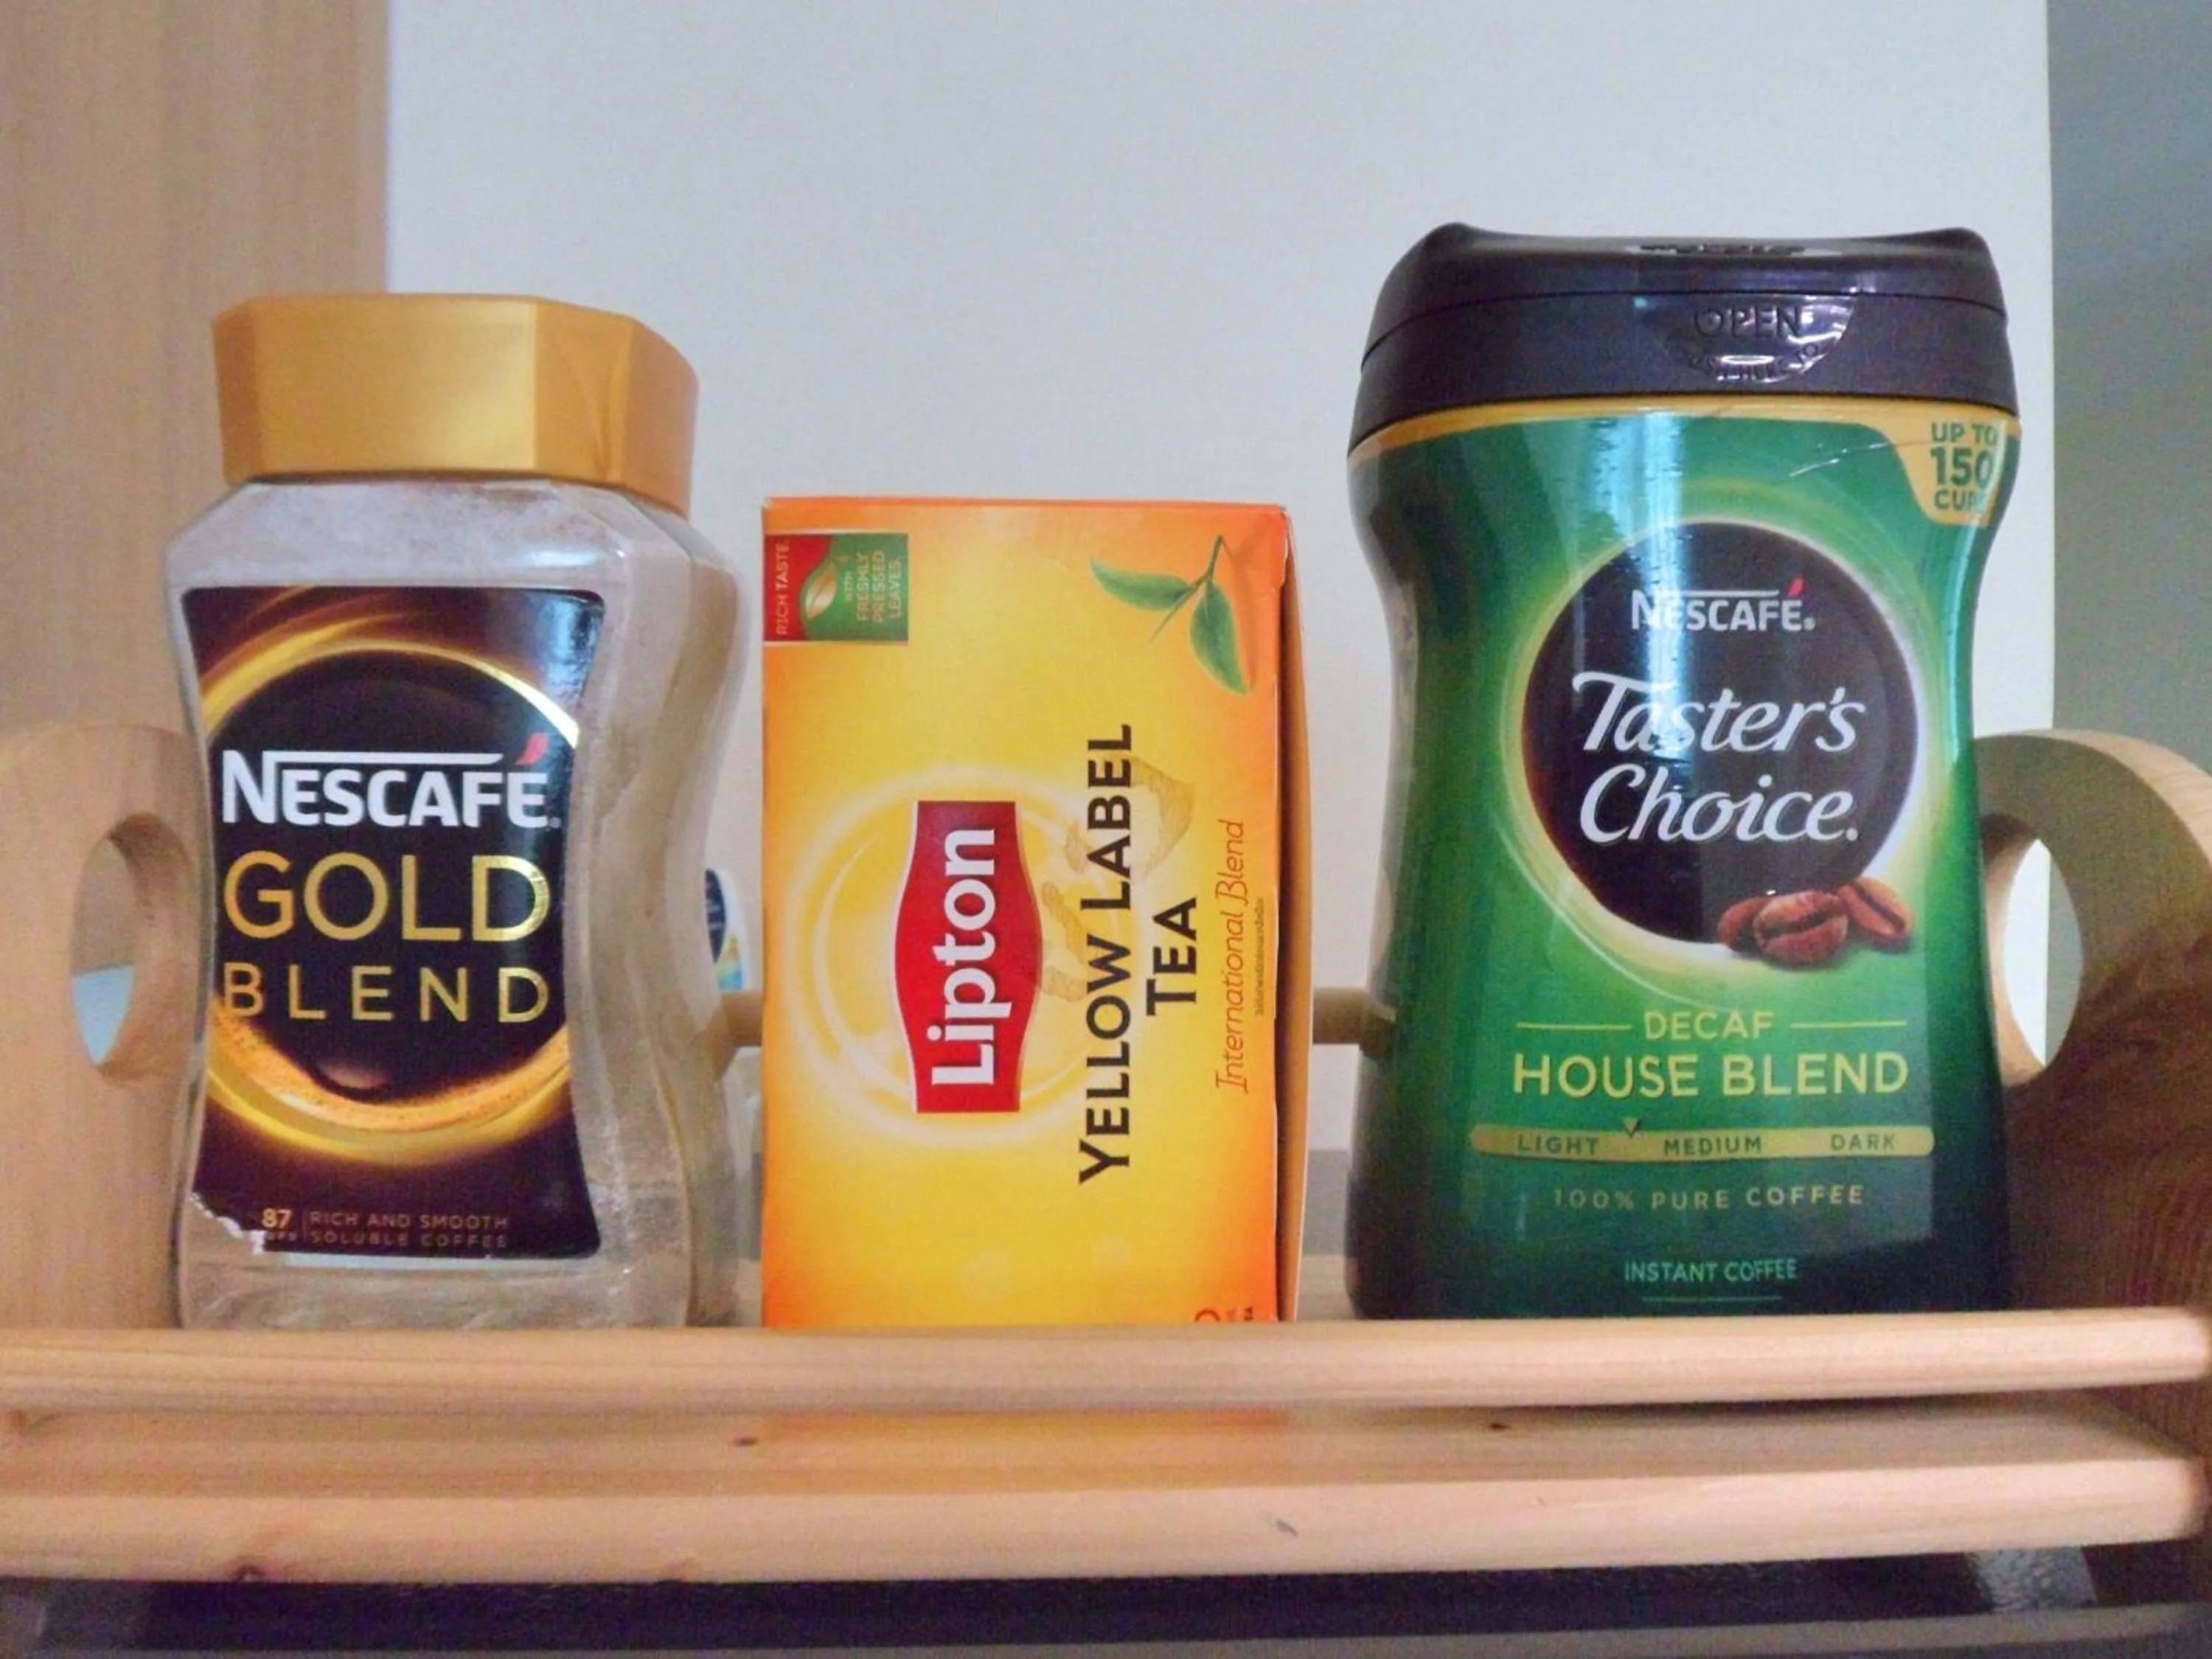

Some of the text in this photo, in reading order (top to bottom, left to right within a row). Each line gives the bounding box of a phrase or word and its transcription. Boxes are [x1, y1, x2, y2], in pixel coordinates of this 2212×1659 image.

[1697, 305, 1801, 338] OPEN
[1931, 422, 1997, 446] UP TO
[1930, 446, 1995, 488] 150
[857, 552, 869, 622] FRESHLY
[872, 551, 885, 623] PRESSED
[776, 593, 789, 635] RICH
[1573, 671, 1865, 753] Taster's
[223, 732, 552, 827] NESCAFÉ
[224, 850, 550, 941] GOLD
[927, 827, 1012, 1086] Lipton
[1079, 723, 1131, 1183] YELLOW LABEL
[1145, 897, 1197, 1017] TEA
[1215, 819, 1249, 1094] International Blend
[223, 962, 550, 1023] BLEND
[1644, 1010, 1773, 1042] DECAF
[1514, 1052, 1909, 1099] HOUSE BLEND
[1517, 1133, 1599, 1155] LIGHT
[1663, 1135, 1761, 1155] MEDIUM
[1831, 1133, 1896, 1151] DARK
[262, 1208, 292, 1228] 87
[1554, 1184, 1865, 1211] 100% PURE COFFEE
[310, 1211, 508, 1231] RICH AND SMOOTH
[310, 1231, 507, 1248] SOLUBLE COFFEE
[1624, 1259, 1798, 1283] INSTANT COFFEE
